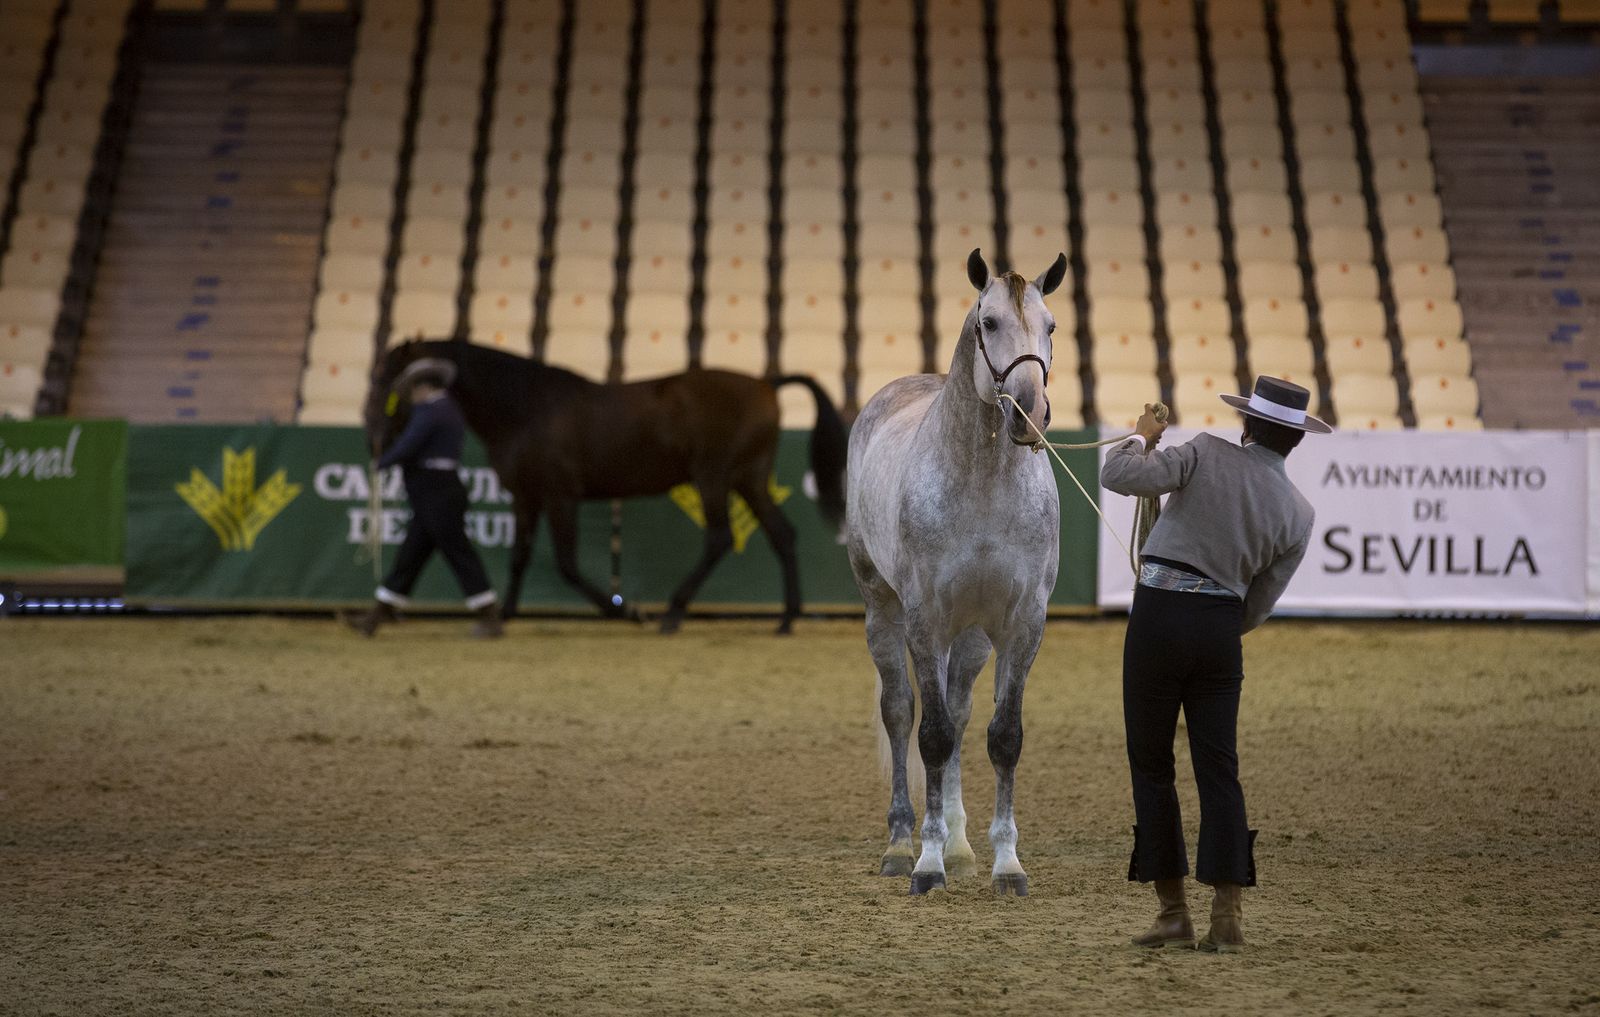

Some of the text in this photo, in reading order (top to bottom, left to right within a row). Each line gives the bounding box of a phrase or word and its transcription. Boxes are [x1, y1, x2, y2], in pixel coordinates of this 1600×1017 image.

[0, 424, 81, 481] mal
[1322, 461, 1547, 491] AYUNTAMIENTO
[1413, 499, 1448, 522] DE
[1322, 525, 1540, 577] SEVILLA
